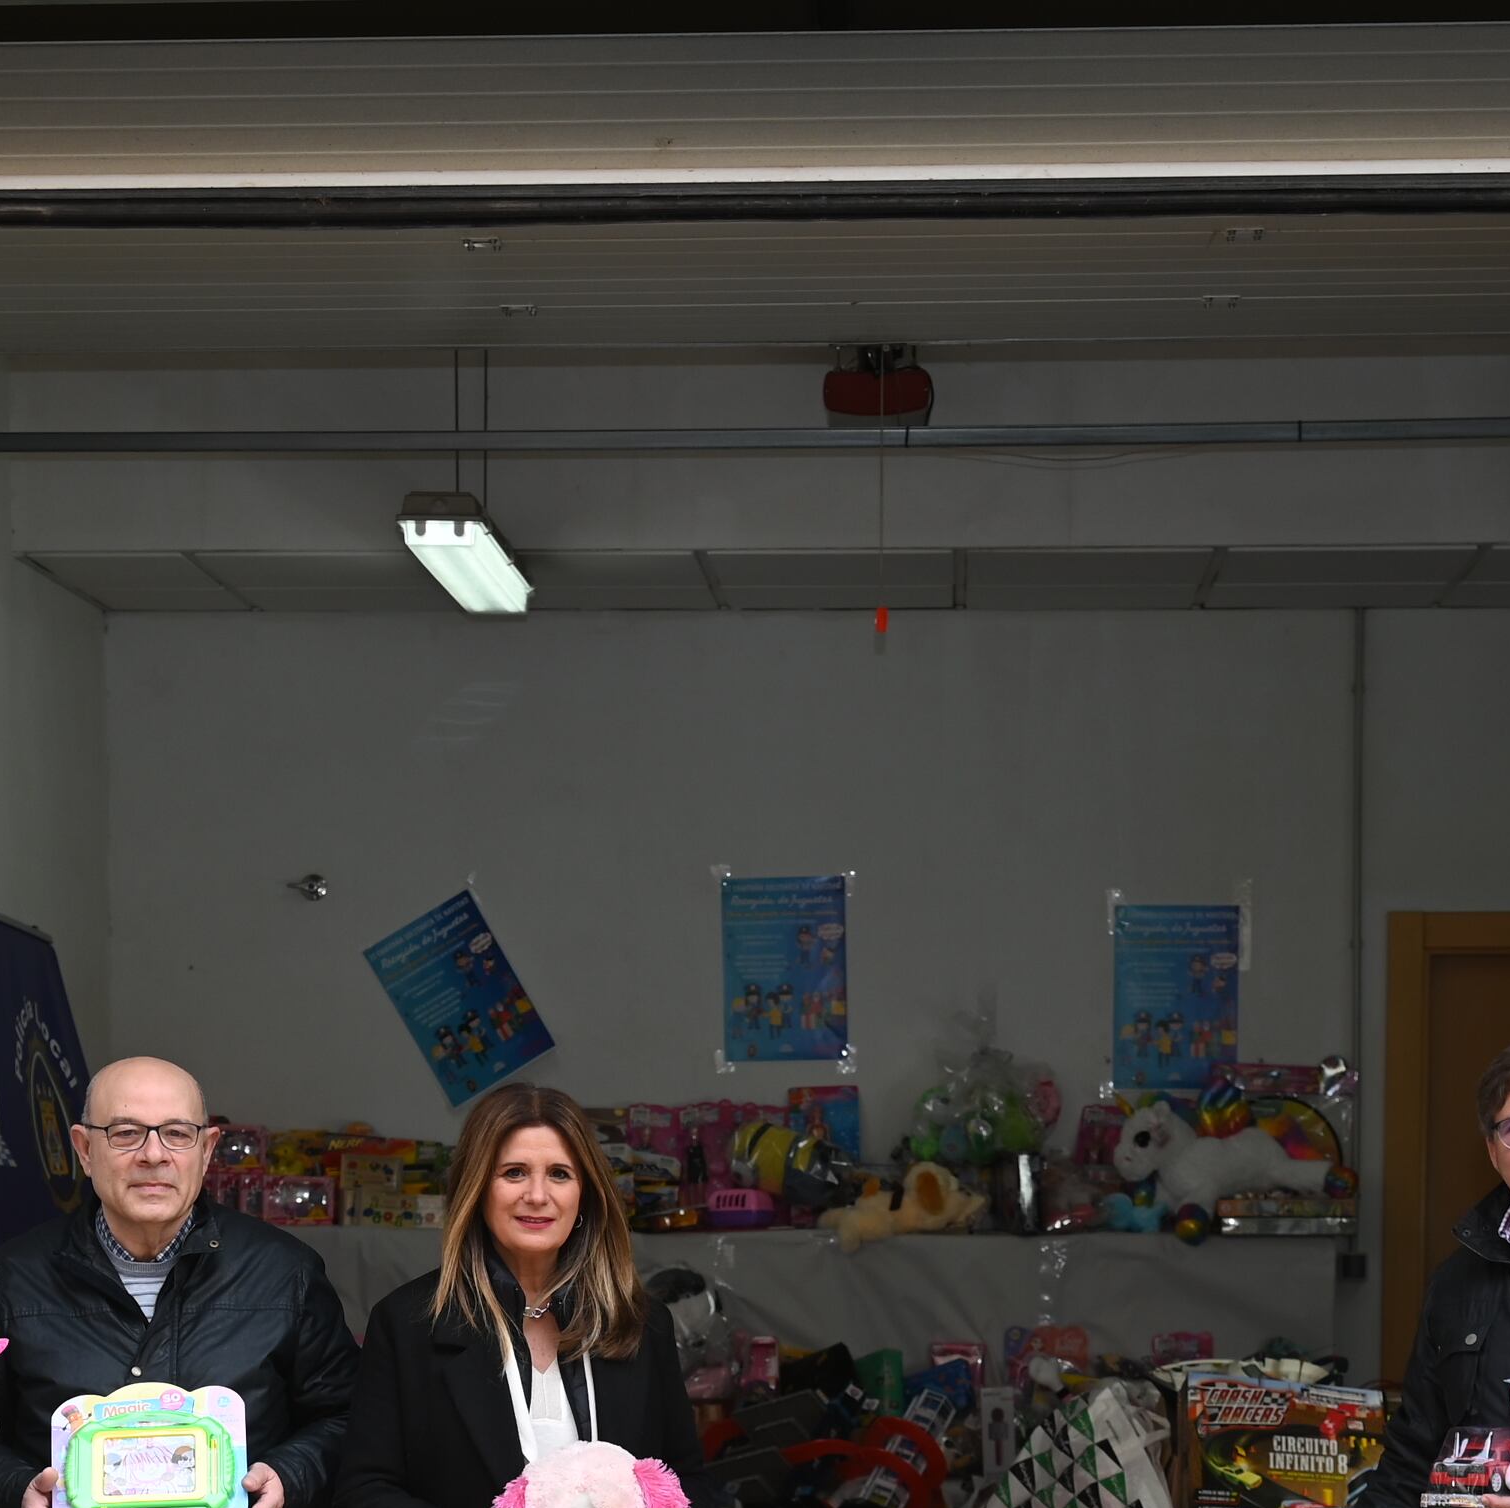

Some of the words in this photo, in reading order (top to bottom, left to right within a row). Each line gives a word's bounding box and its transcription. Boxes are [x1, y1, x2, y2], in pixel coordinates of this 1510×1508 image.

[32, 1002, 78, 1090] Local
[327, 1138, 363, 1151] NERF
[1209, 1388, 1265, 1404] CRASH
[103, 1403, 150, 1418] Magic
[1218, 1406, 1288, 1425] RACERS
[1272, 1435, 1339, 1456] CIRCUITO
[1268, 1452, 1334, 1474] INFINITO
[1337, 1454, 1349, 1475] 8
